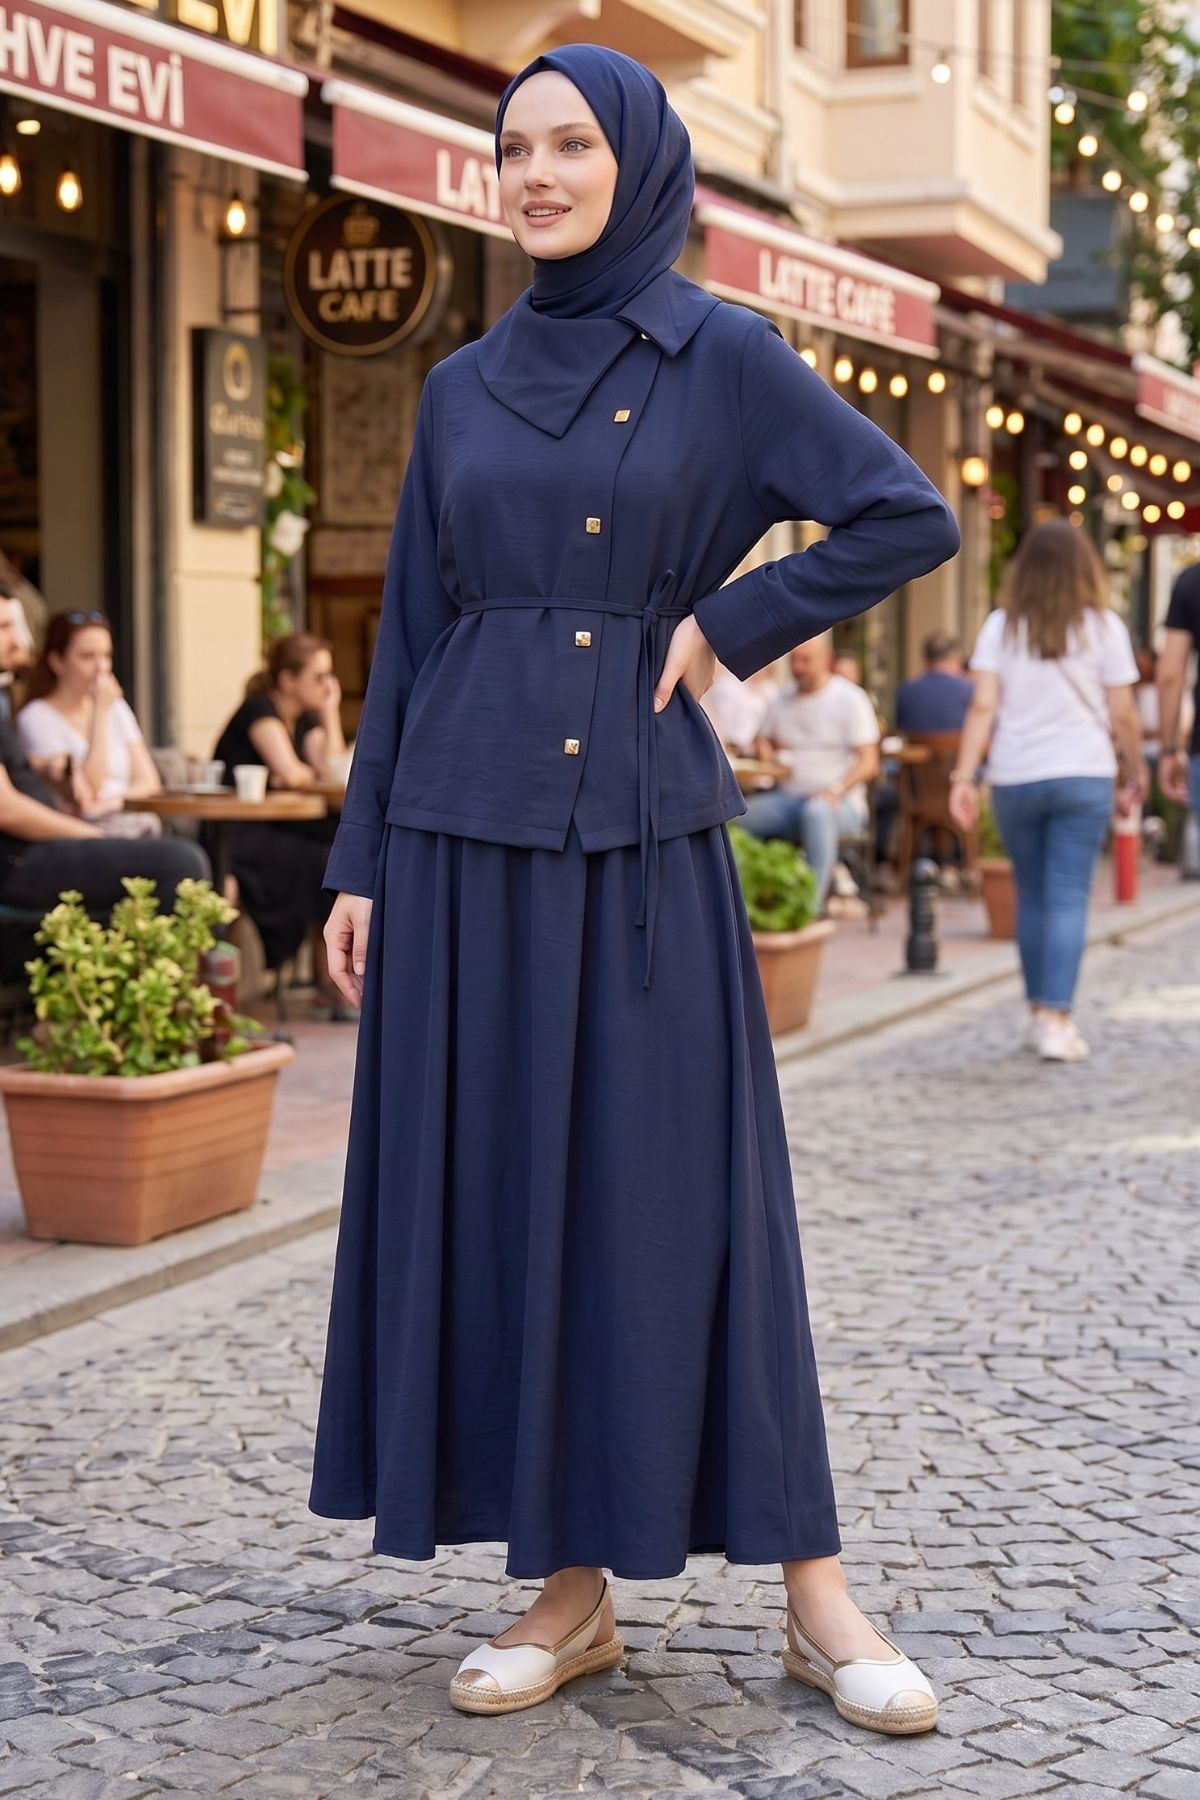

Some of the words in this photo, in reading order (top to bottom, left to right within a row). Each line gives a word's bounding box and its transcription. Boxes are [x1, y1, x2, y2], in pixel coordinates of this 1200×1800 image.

[0, 6, 96, 100] HVE
[308, 248, 412, 290] LATTE
[758, 248, 836, 317] LATTE
[318, 290, 399, 323] CAFE
